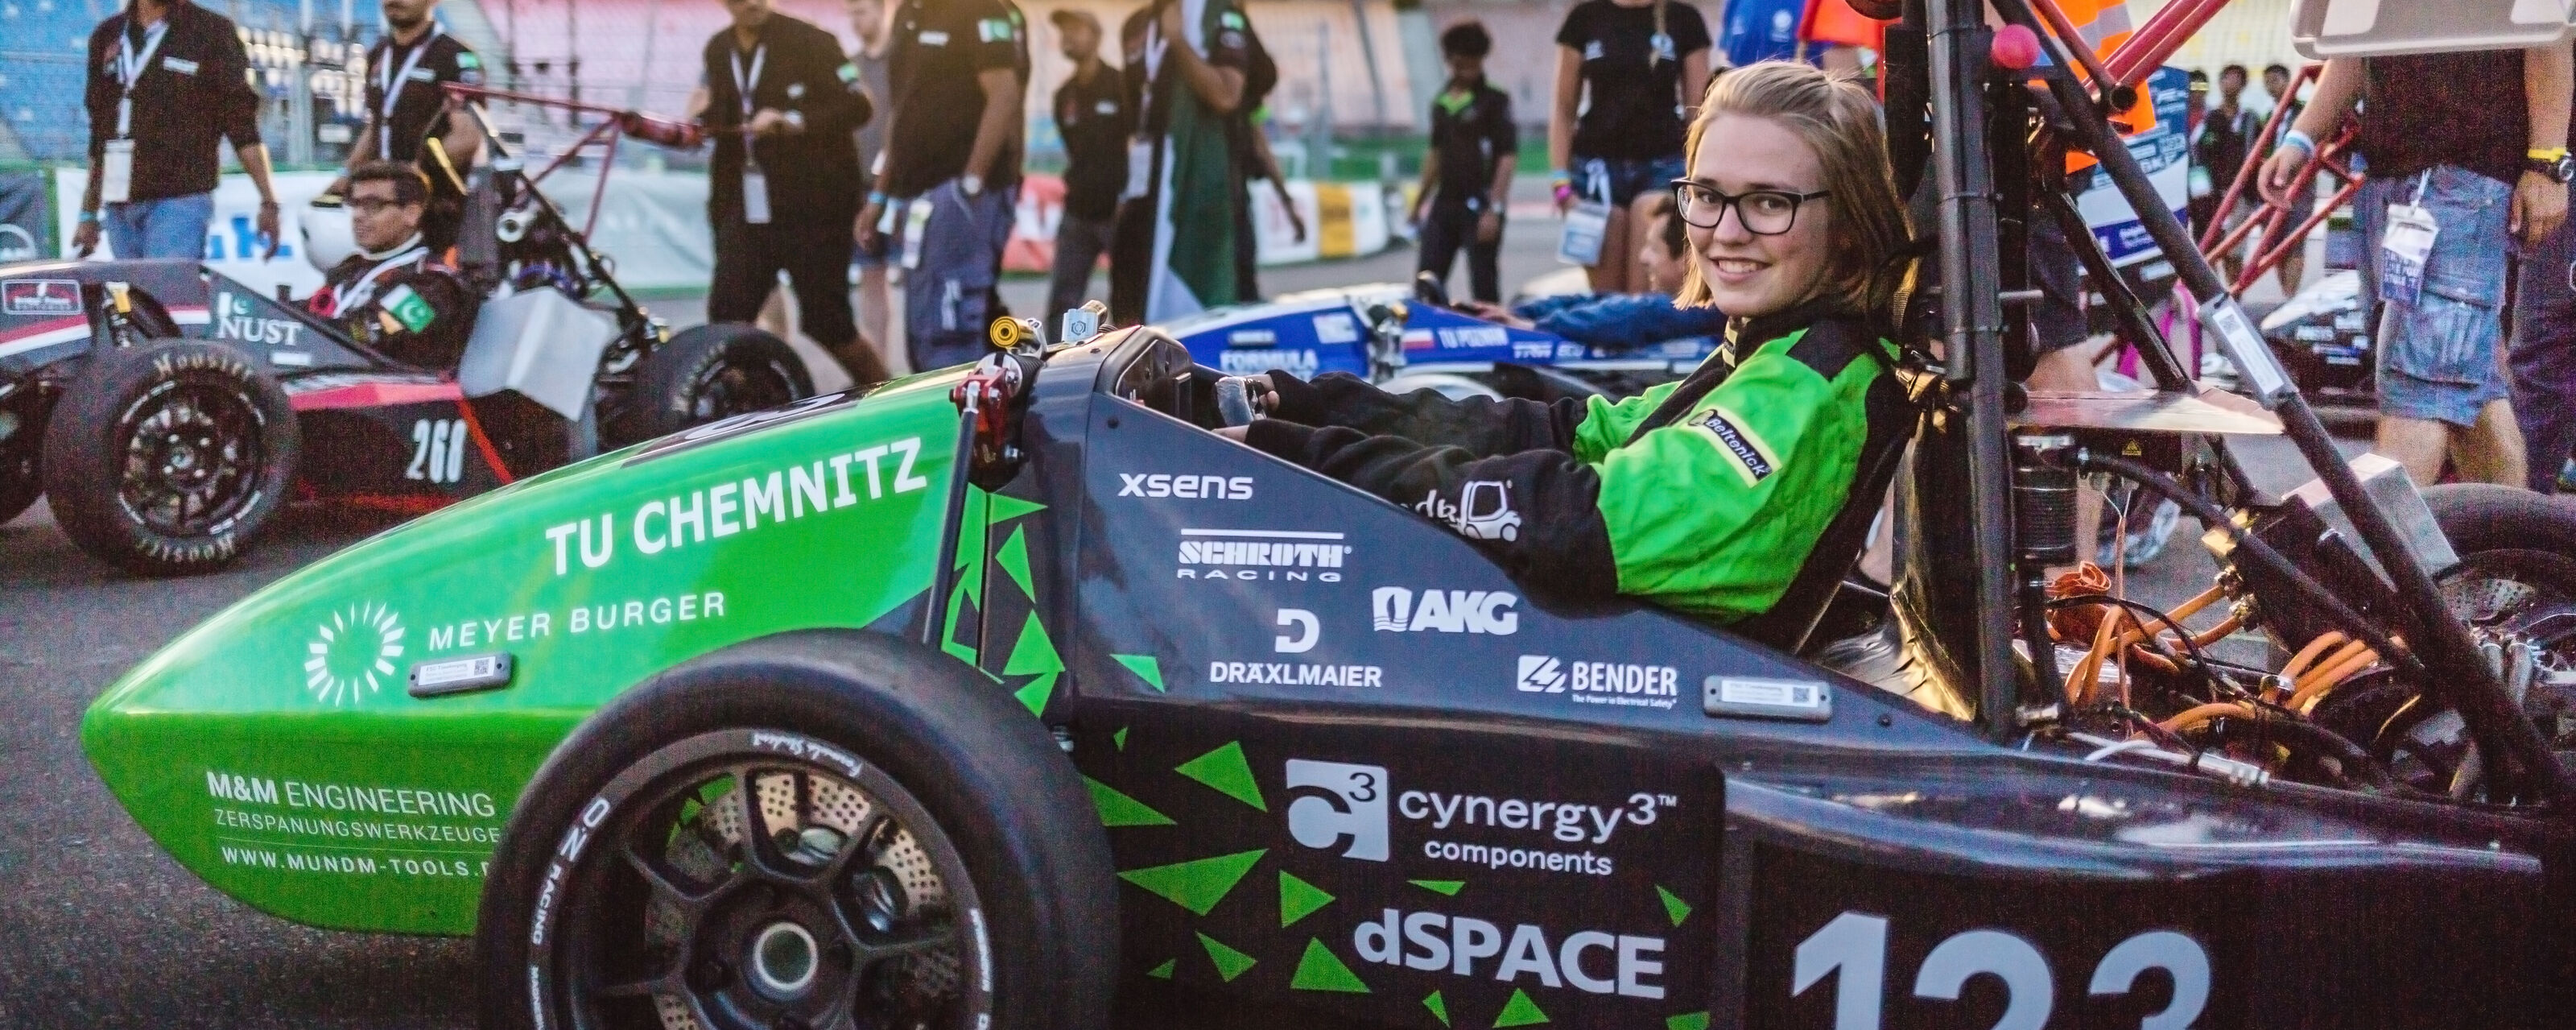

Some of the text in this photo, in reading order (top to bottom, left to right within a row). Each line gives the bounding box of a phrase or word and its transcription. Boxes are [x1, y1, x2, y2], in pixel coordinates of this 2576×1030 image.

[217, 316, 303, 345] NUST
[1117, 474, 1253, 499] xsens
[546, 437, 927, 576] TU CHEMNITZ
[1177, 569, 1342, 582] RACING
[428, 592, 725, 652] MEYER BURGER
[1409, 589, 1517, 635] AKG
[1210, 662, 1382, 688] DRÄXLMAIER
[1571, 661, 1678, 696] BENDER
[1572, 694, 1585, 703] The
[1586, 695, 1608, 705] Power
[1616, 697, 1648, 706] Electrical
[206, 771, 495, 817] M&M ENGINEERING
[214, 809, 500, 843] ZERSPANUNGSWERKZEUGE
[1424, 839, 1612, 876] components
[531, 863, 562, 946] RACING
[1354, 908, 1665, 999] dSPACE
